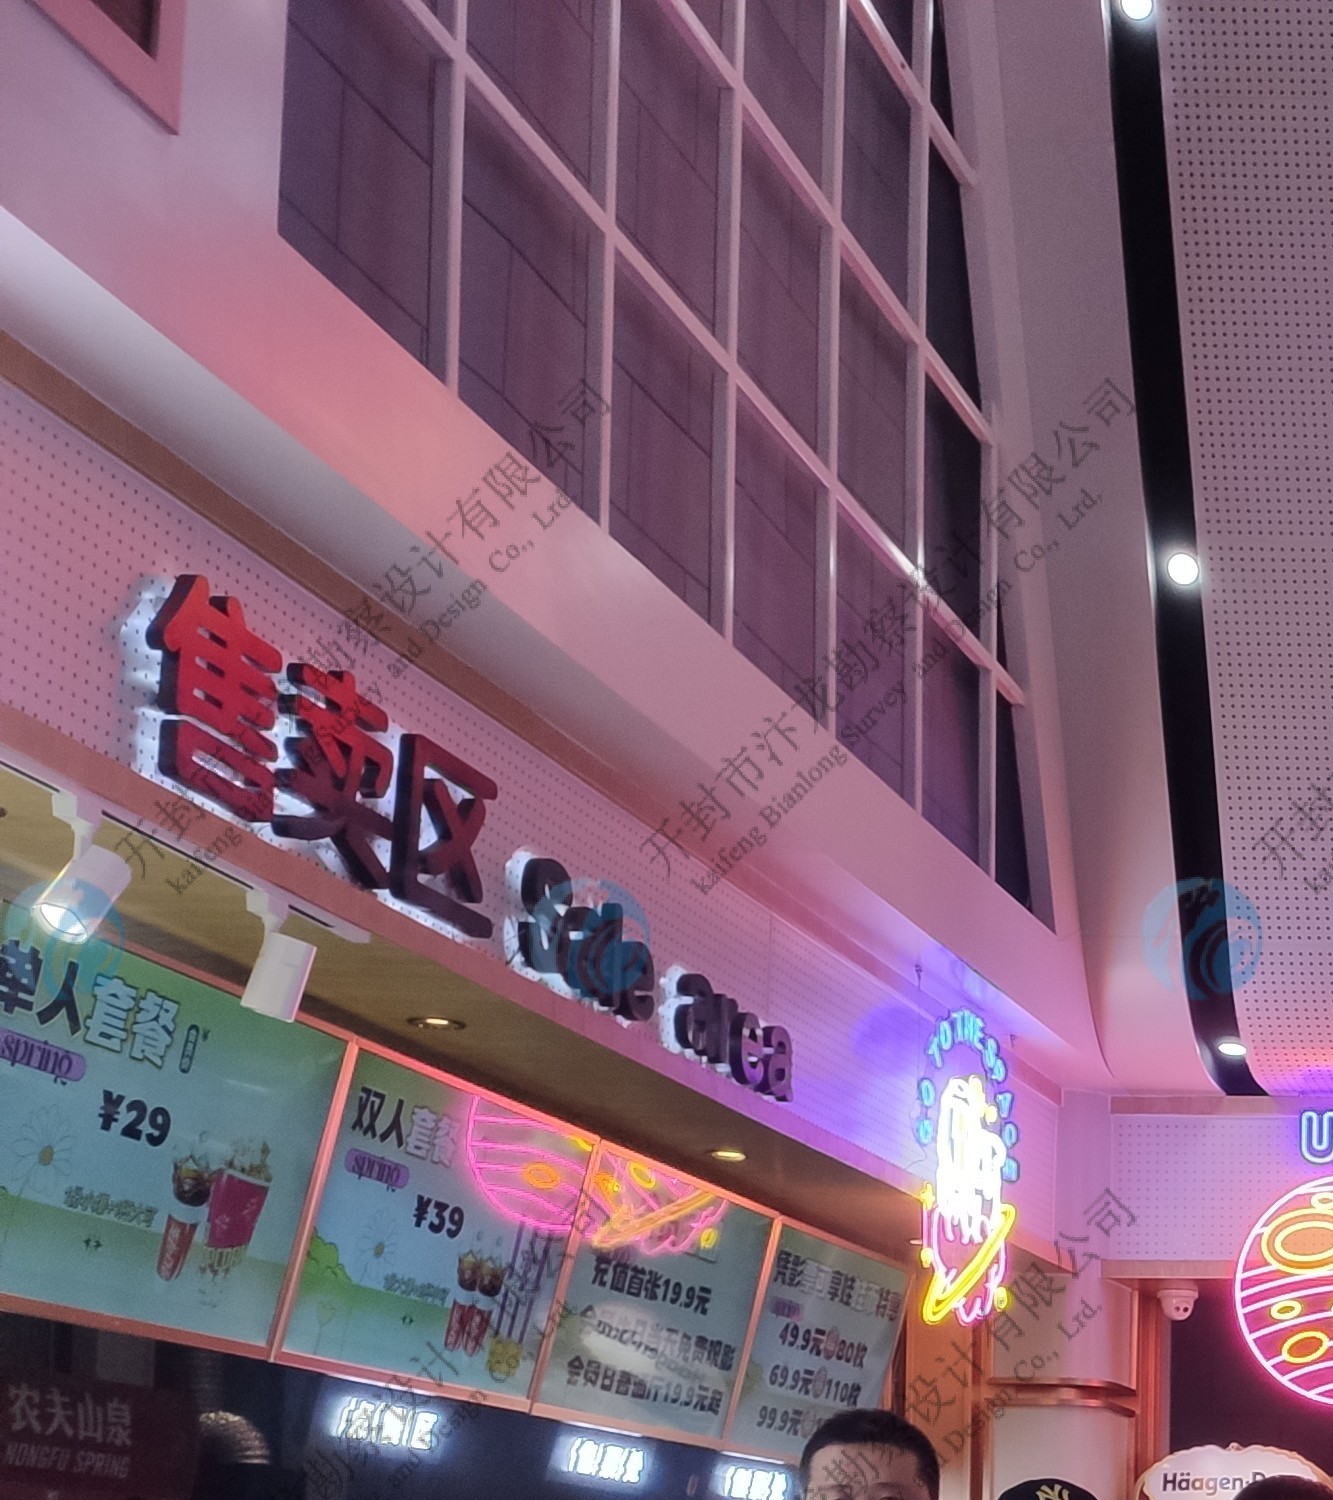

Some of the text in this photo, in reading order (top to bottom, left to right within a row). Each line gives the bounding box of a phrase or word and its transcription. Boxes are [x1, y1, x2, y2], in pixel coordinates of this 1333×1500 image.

[145, 574, 793, 1102] 售卖区 Sale area
[98, 1089, 171, 1147] ¥29
[412, 1194, 465, 1239] ¥39
[6, 1382, 132, 1447] 农夫山泉
[73, 1449, 132, 1480] SPRING
[1162, 1470, 1272, 1496] Häagen-D
